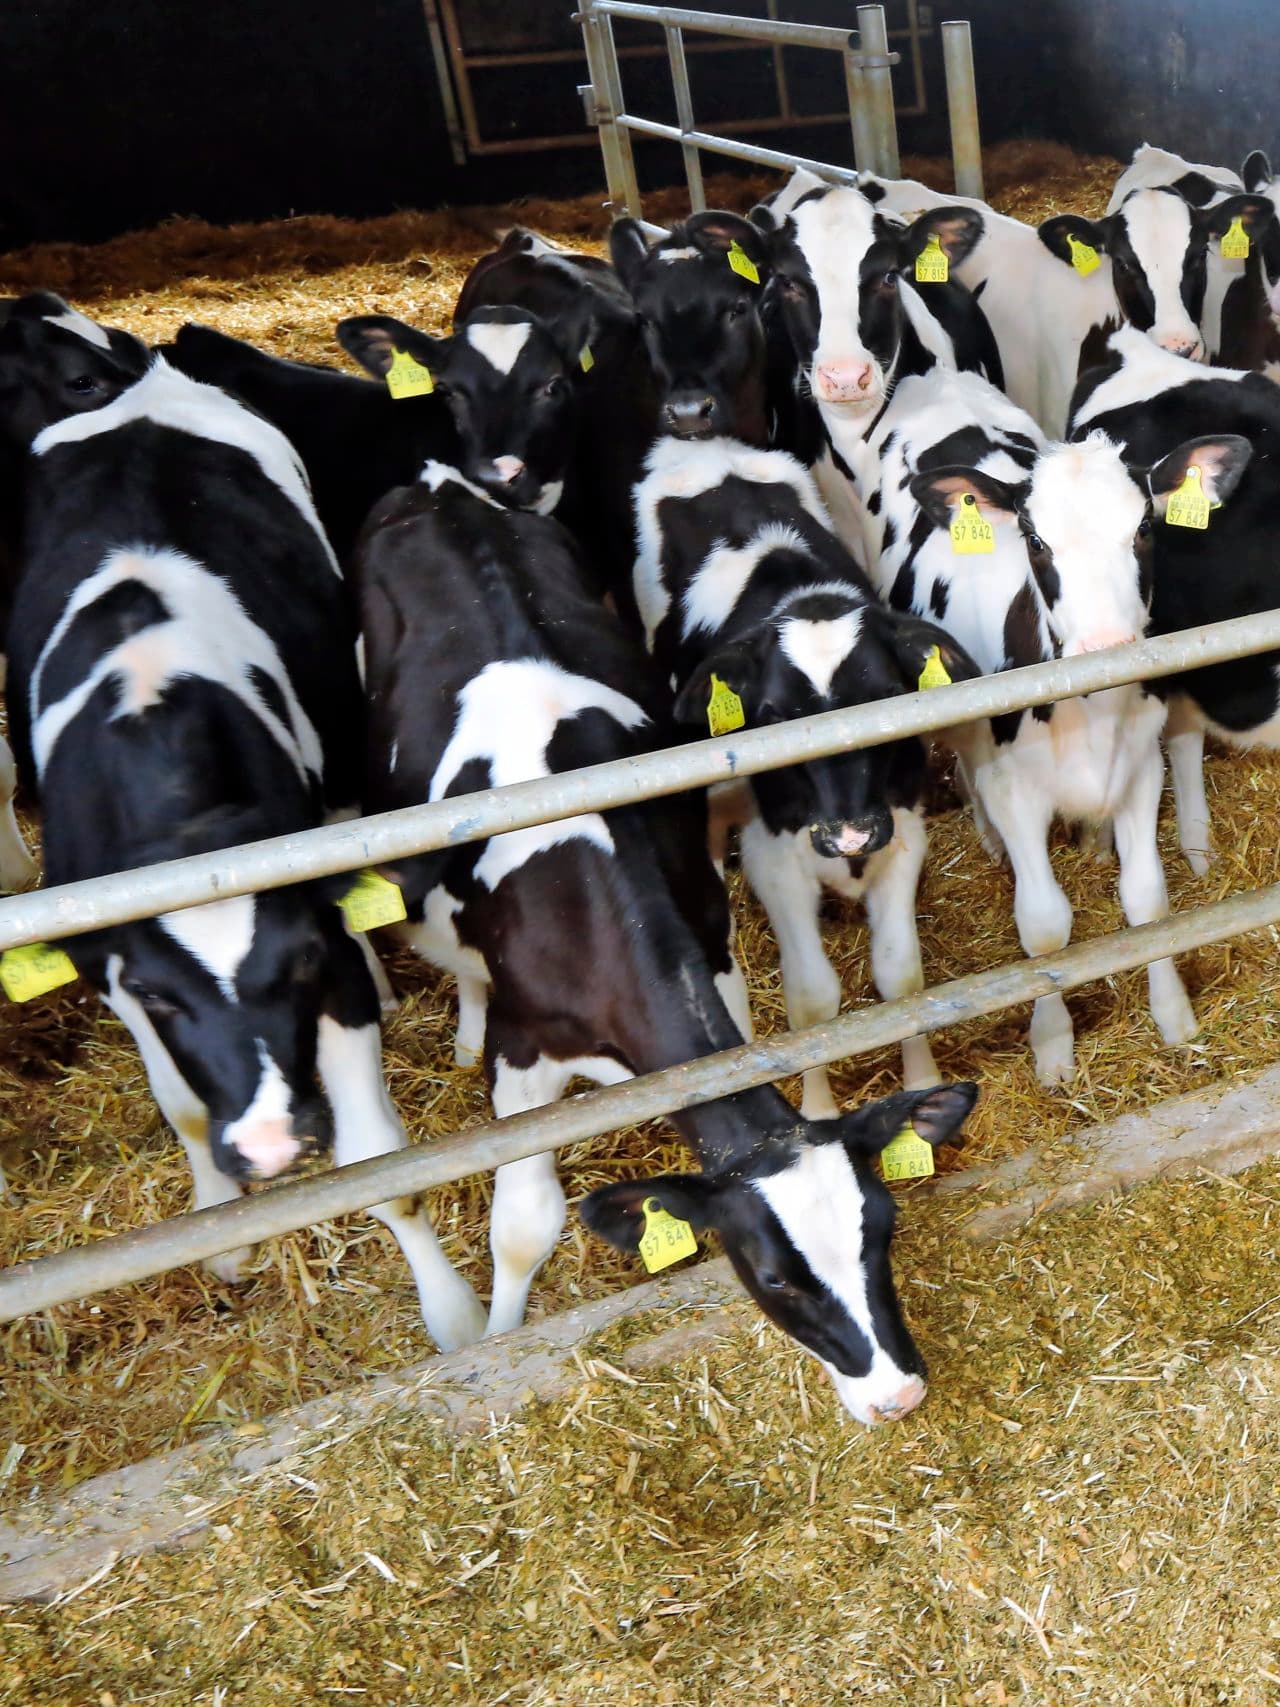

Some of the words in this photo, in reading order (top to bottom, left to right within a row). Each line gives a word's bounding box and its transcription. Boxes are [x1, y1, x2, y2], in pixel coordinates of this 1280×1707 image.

[1169, 508, 1182, 523] 57
[1186, 511, 1207, 528] 842
[954, 526, 966, 541] 57
[972, 525, 991, 540] 842
[887, 1163, 902, 1179] 57
[909, 1160, 931, 1176] 841
[645, 1236, 660, 1257] 57
